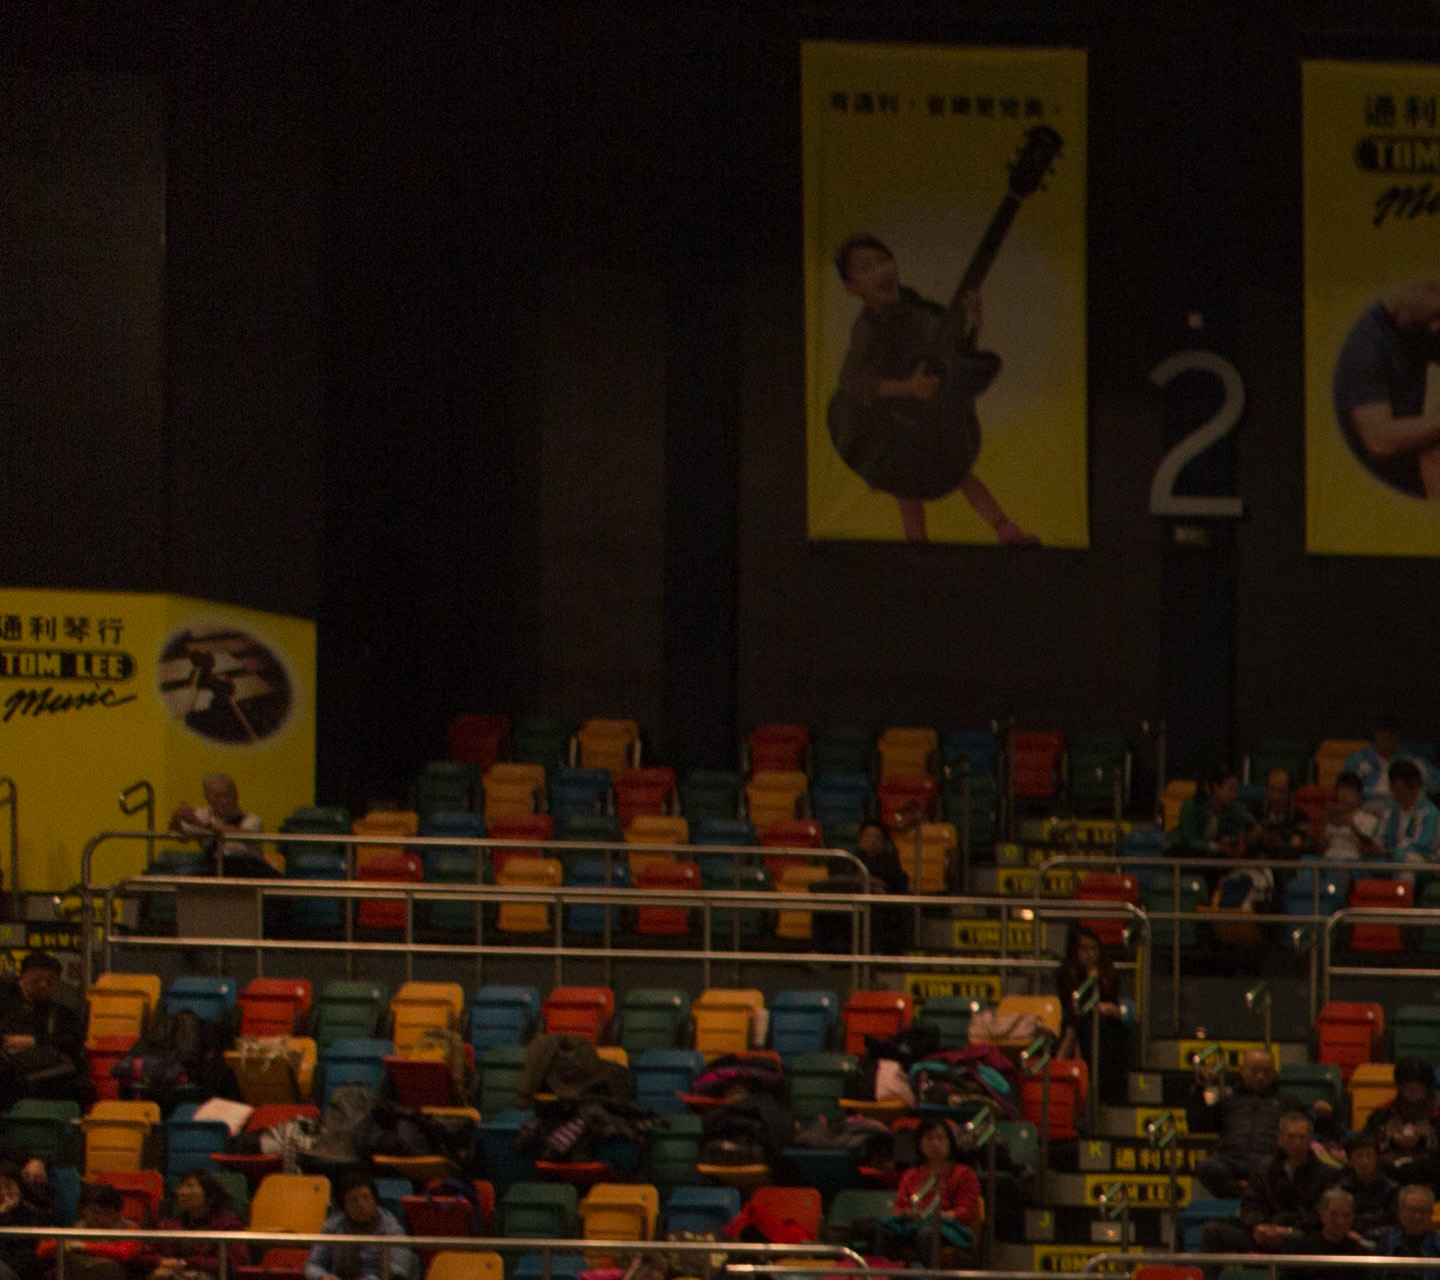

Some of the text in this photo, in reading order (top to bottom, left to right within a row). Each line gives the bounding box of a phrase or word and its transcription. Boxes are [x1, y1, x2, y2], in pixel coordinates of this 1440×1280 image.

[1149, 350, 1247, 518] 2
[6, 652, 125, 679] TOM LEE
[3, 683, 138, 722] Music
